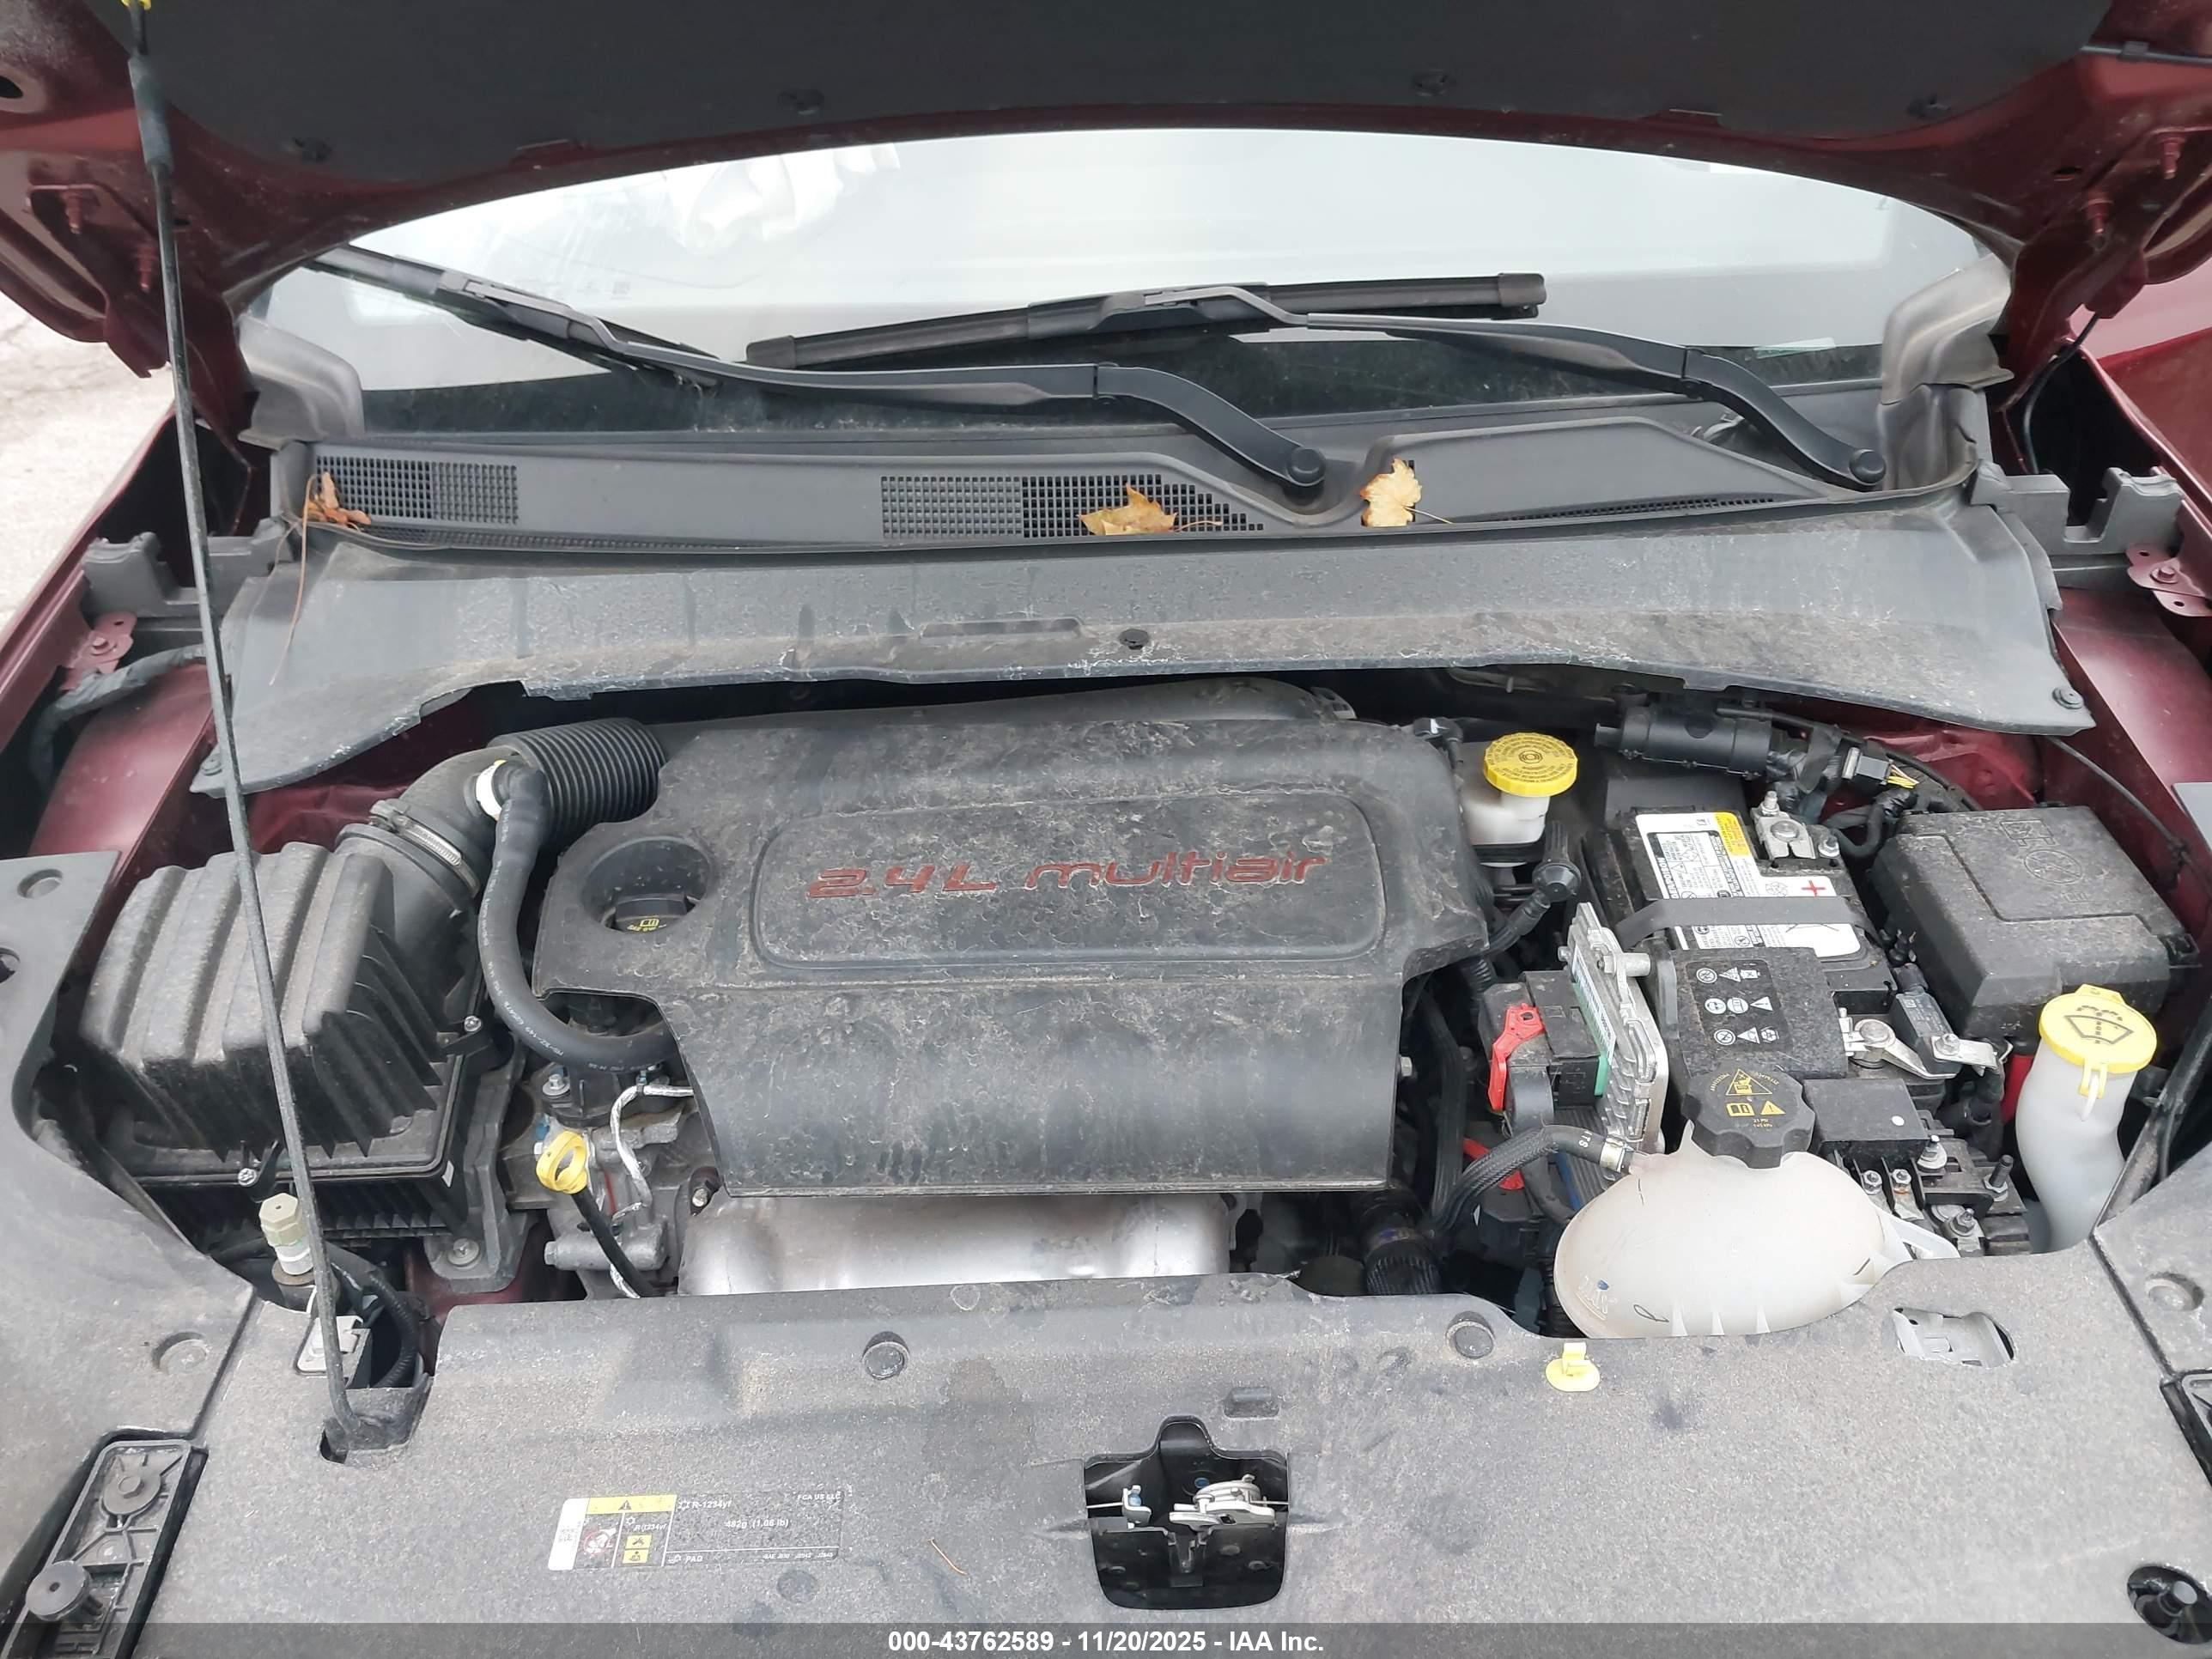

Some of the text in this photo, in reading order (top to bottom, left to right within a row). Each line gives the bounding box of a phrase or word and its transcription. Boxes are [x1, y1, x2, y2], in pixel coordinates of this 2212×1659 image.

[806, 848, 1328, 898] 2.4L multiair
[814, 1492, 825, 1501] US
[691, 1497, 732, 1510] R-1234yf
